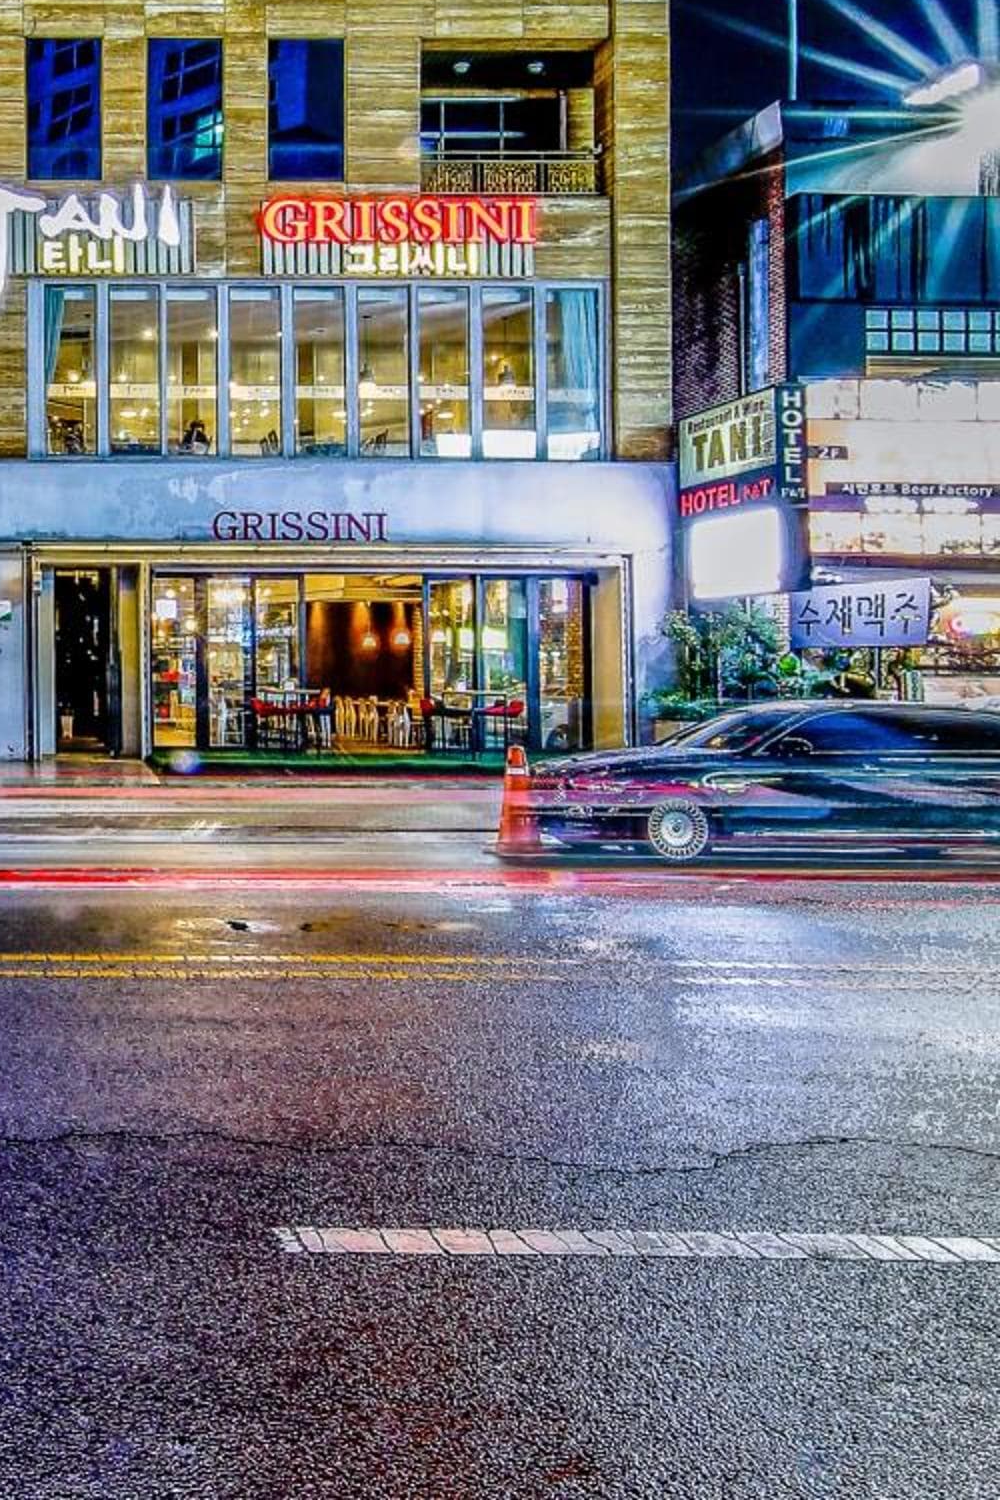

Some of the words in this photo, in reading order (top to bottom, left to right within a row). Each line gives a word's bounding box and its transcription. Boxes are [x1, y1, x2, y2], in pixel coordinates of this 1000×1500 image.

[262, 197, 536, 244] GRISSINI
[43, 235, 124, 274] 타니
[692, 415, 761, 473] TANI
[782, 390, 802, 483] HOTEL
[818, 447, 841, 460] 2F
[680, 483, 740, 517] HOTEL
[900, 484, 935, 496] Beer
[938, 484, 994, 498] Factory
[212, 510, 389, 542] GRISSINI
[797, 592, 924, 638] 수제맥주
